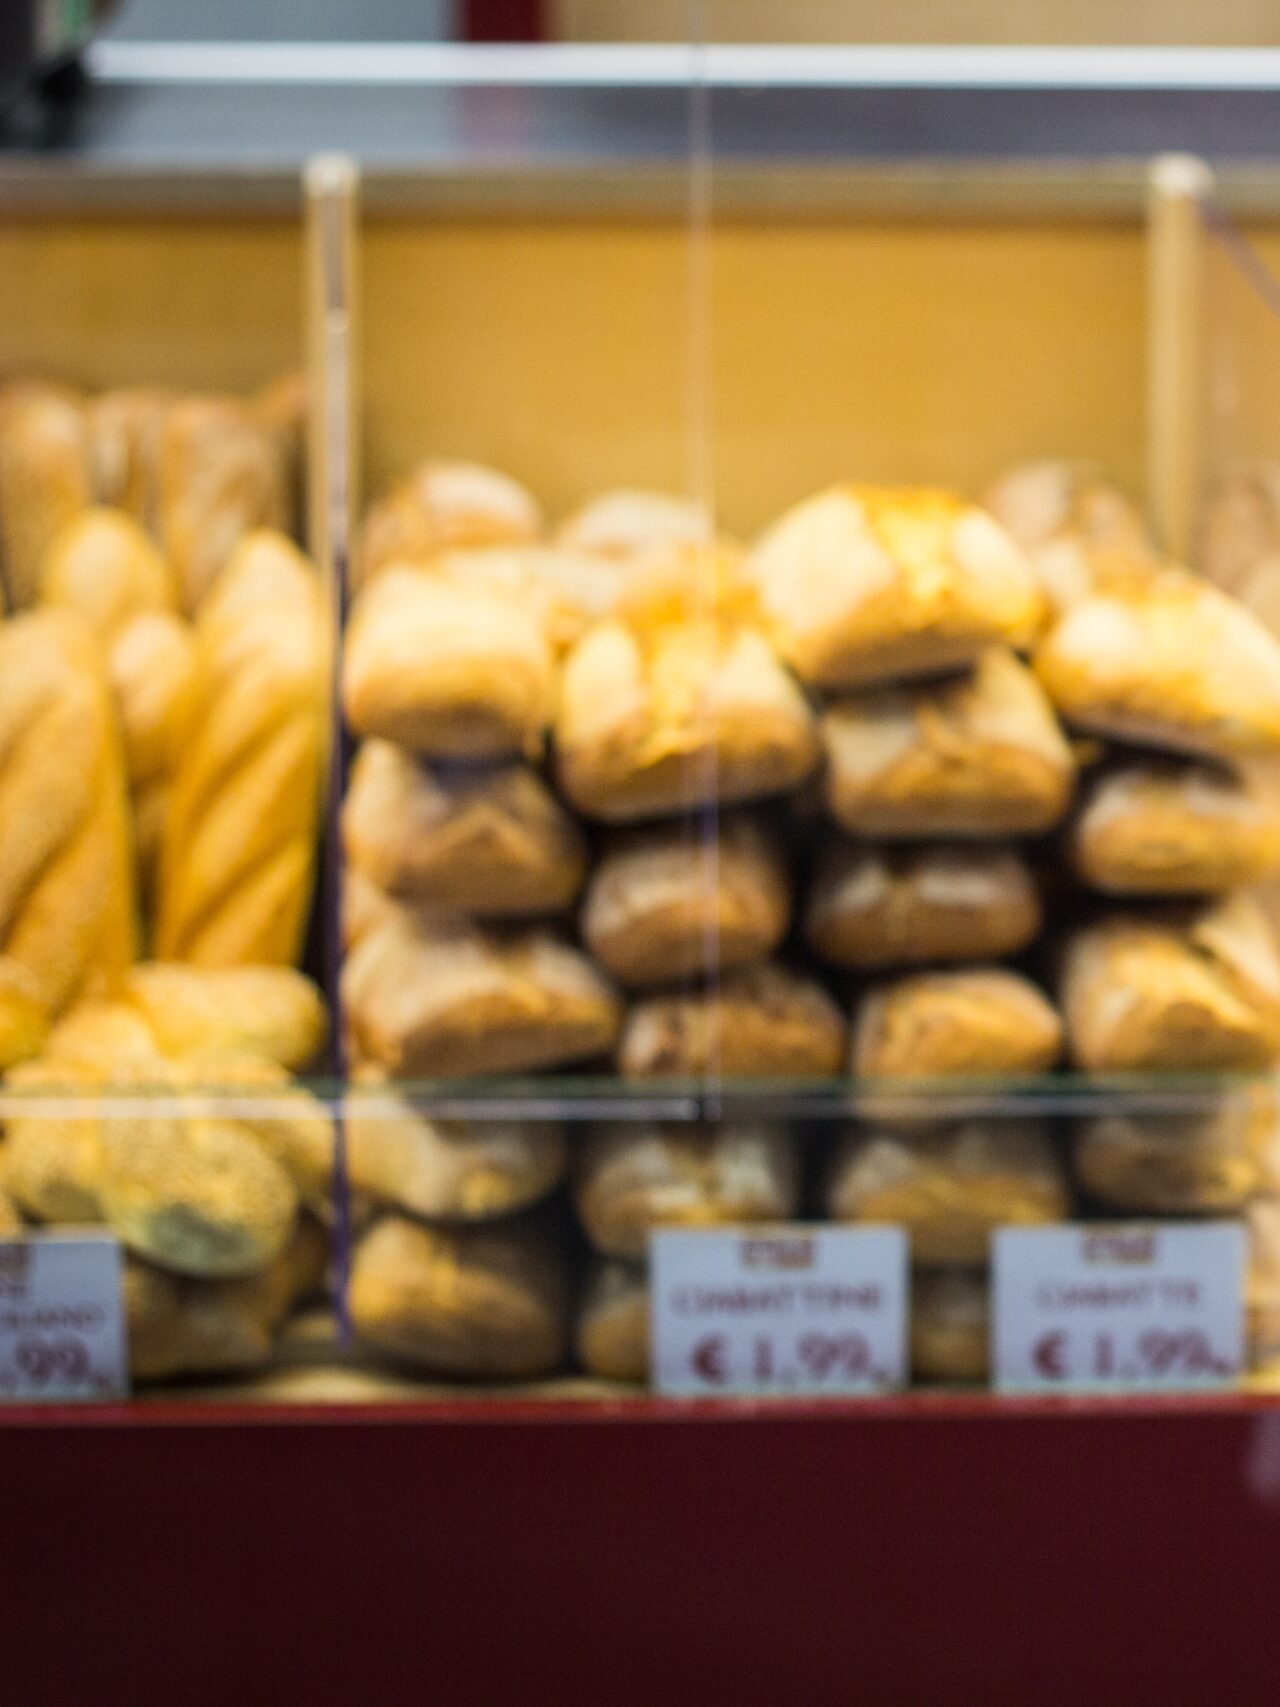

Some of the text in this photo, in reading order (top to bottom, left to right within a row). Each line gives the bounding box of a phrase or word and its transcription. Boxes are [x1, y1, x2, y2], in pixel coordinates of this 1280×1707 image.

[691, 1334, 729, 1384] €
[755, 1332, 871, 1383] 1.99
[1032, 1330, 1069, 1379] €
[1095, 1328, 1212, 1379] 1.99
